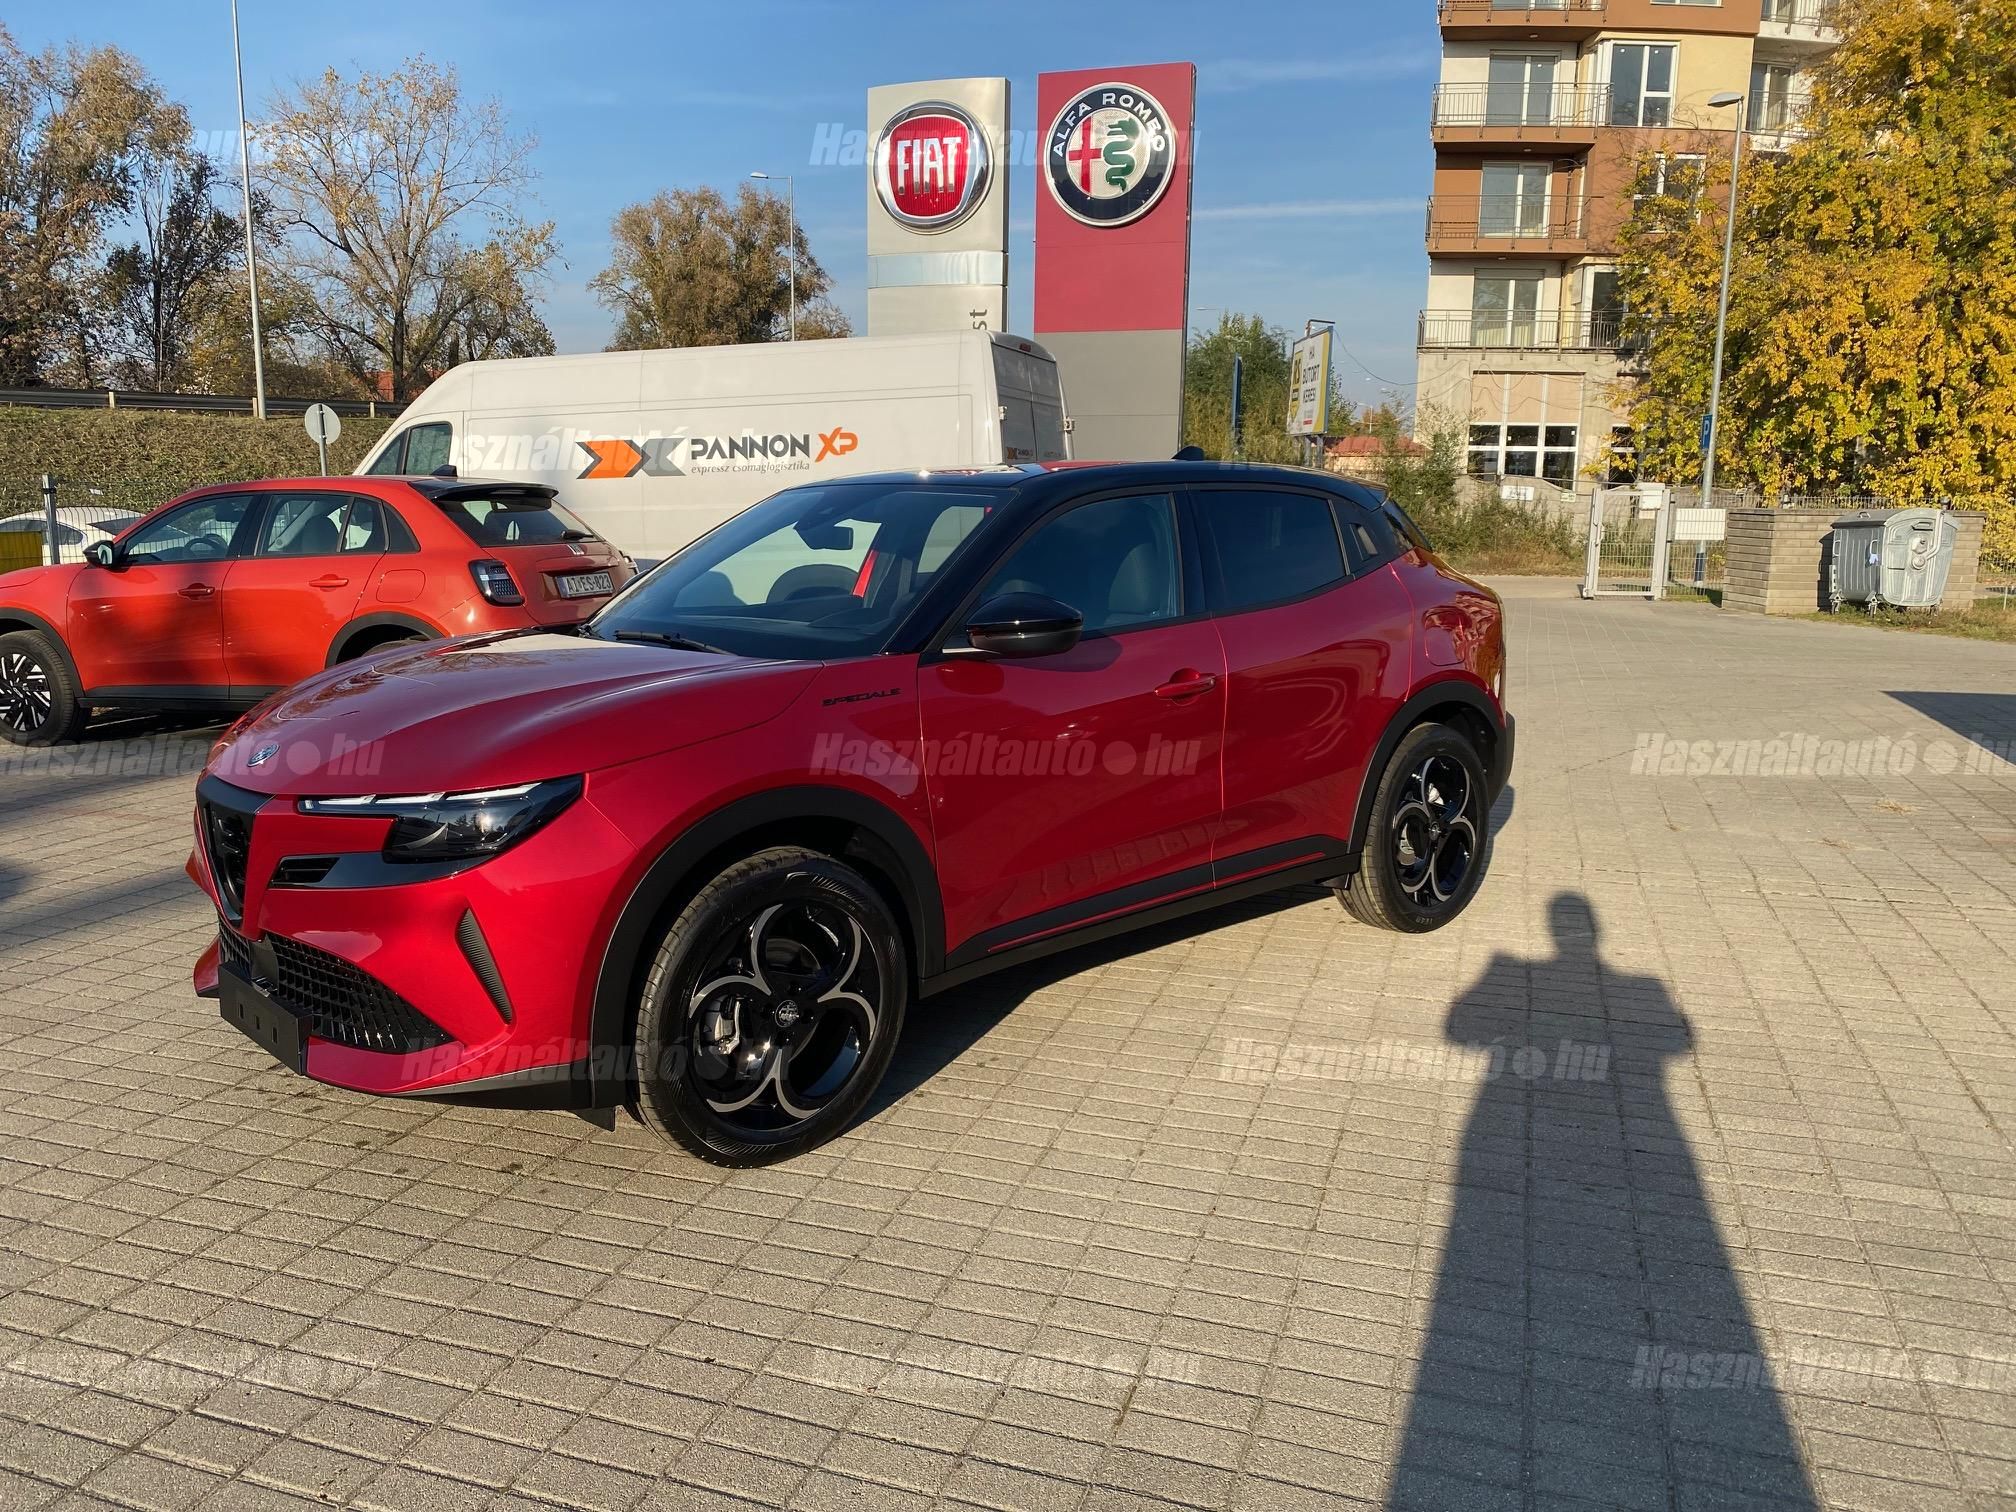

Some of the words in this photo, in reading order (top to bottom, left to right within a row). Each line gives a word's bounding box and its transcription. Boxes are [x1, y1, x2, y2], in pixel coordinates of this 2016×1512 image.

[1053, 102, 1092, 157] ALFA
[1102, 92, 1166, 152] ROMEO
[897, 136, 961, 195] FIAT
[691, 433, 810, 460] PANNON
[815, 426, 858, 463] XP
[691, 464, 730, 476] expressz
[732, 460, 810, 474] csomaglogisztika
[821, 687, 904, 707] SPECIALE
